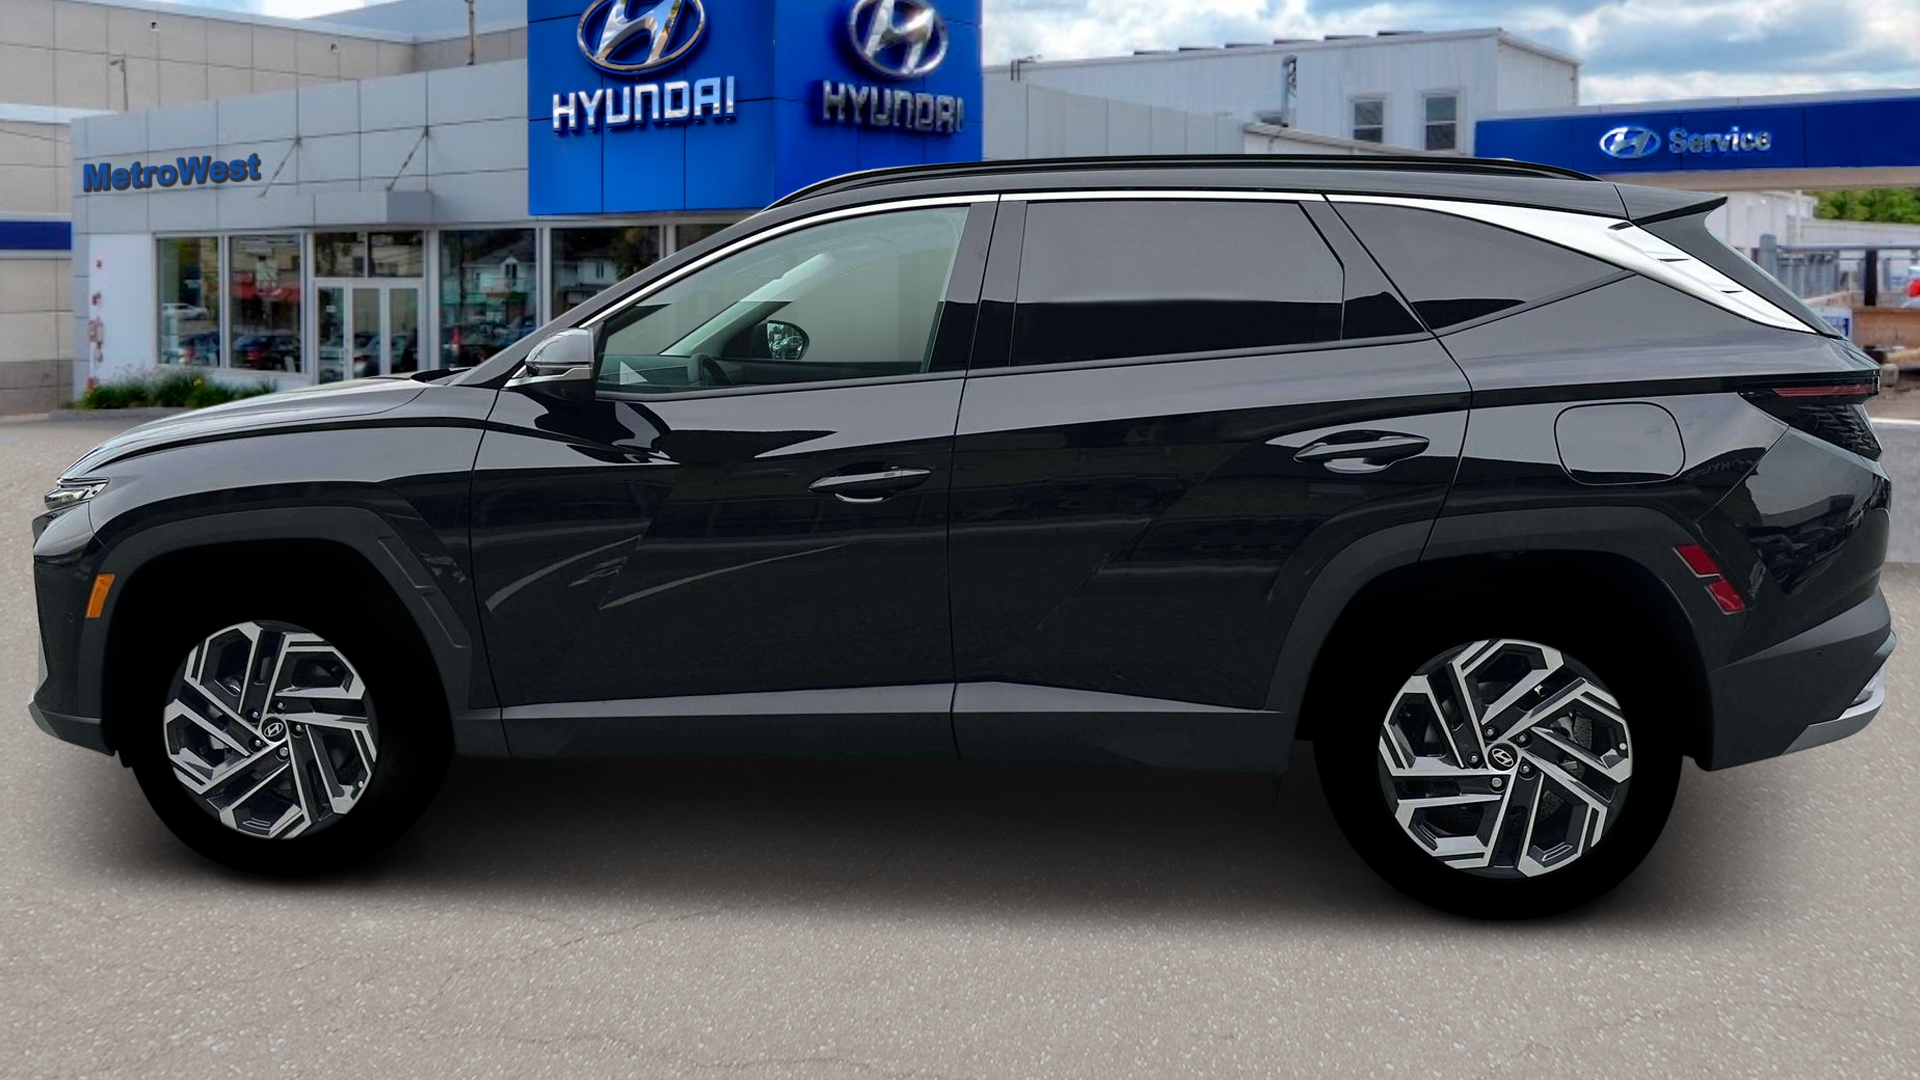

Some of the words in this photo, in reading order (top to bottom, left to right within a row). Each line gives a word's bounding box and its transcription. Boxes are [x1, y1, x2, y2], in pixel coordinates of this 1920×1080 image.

[552, 75, 736, 131] HYUNDAI
[822, 79, 965, 133] HYUNDAI
[1668, 125, 1772, 154] Service
[83, 152, 262, 193] MetroWest
